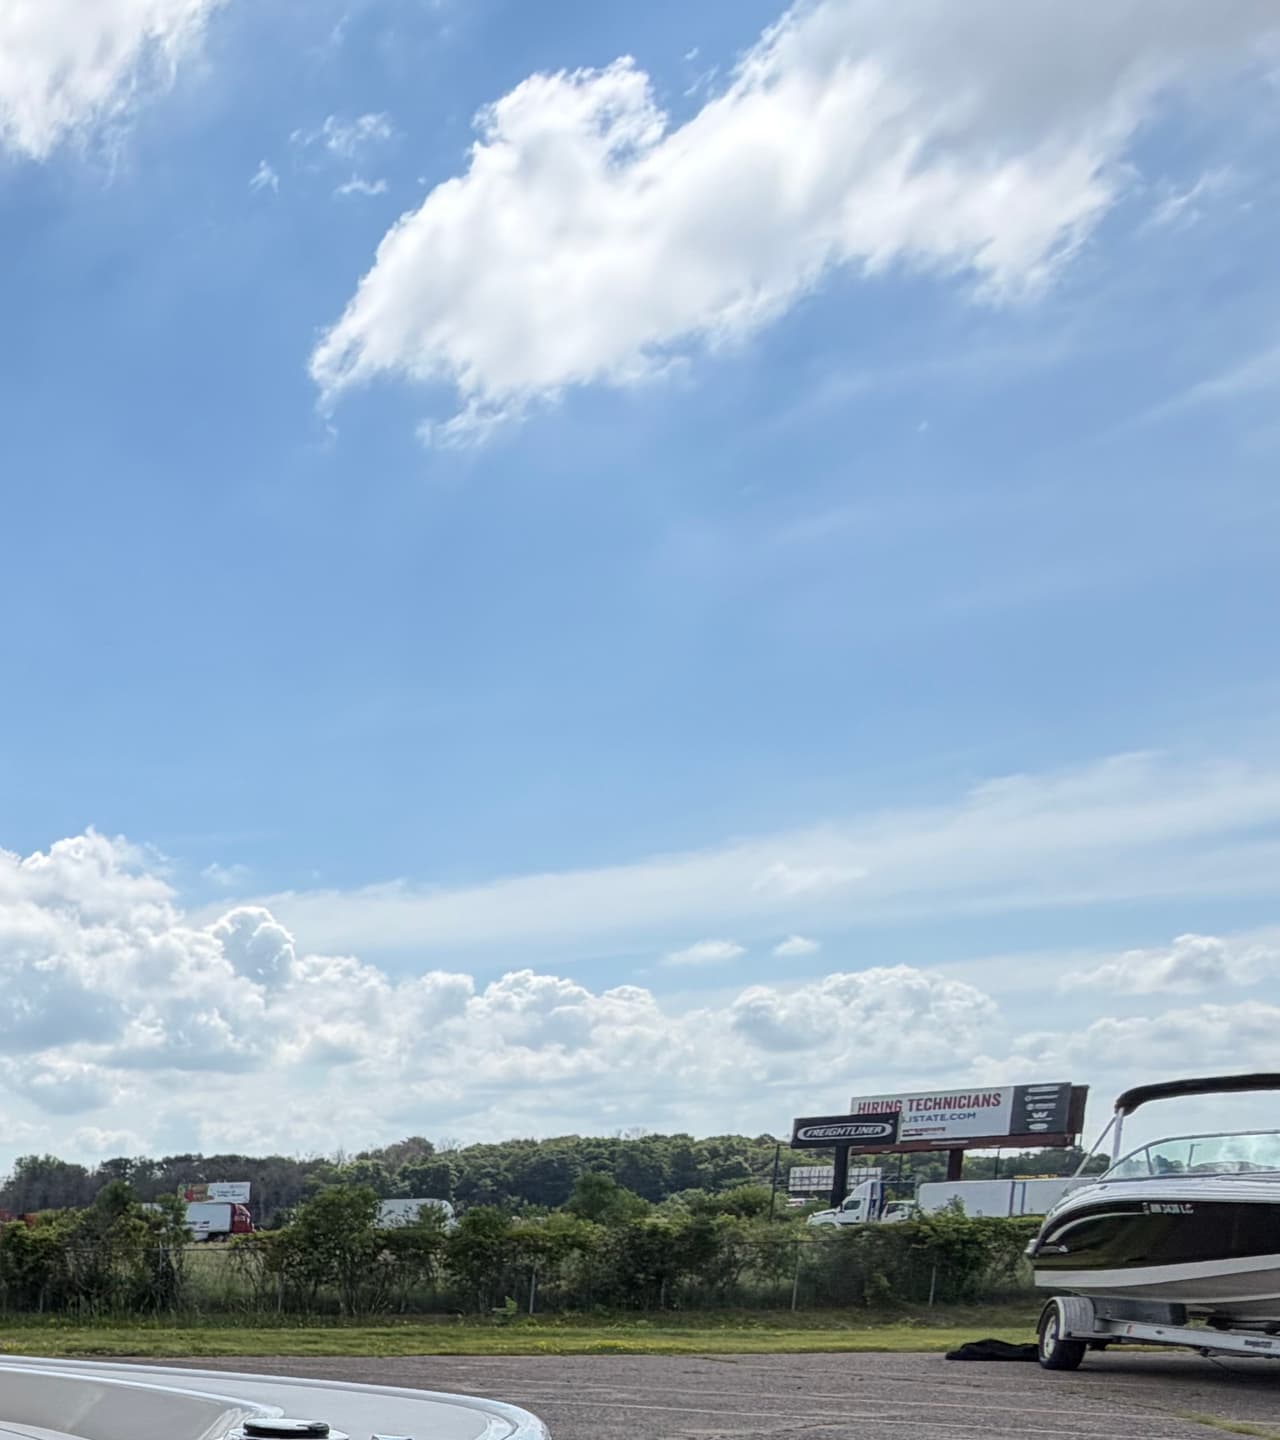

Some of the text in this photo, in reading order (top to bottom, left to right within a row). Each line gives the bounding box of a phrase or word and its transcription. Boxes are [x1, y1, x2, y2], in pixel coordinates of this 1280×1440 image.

[858, 1093, 1001, 1114] HIRING TECHNICIANS
[806, 1126, 882, 1137] FREIGHTLINER
